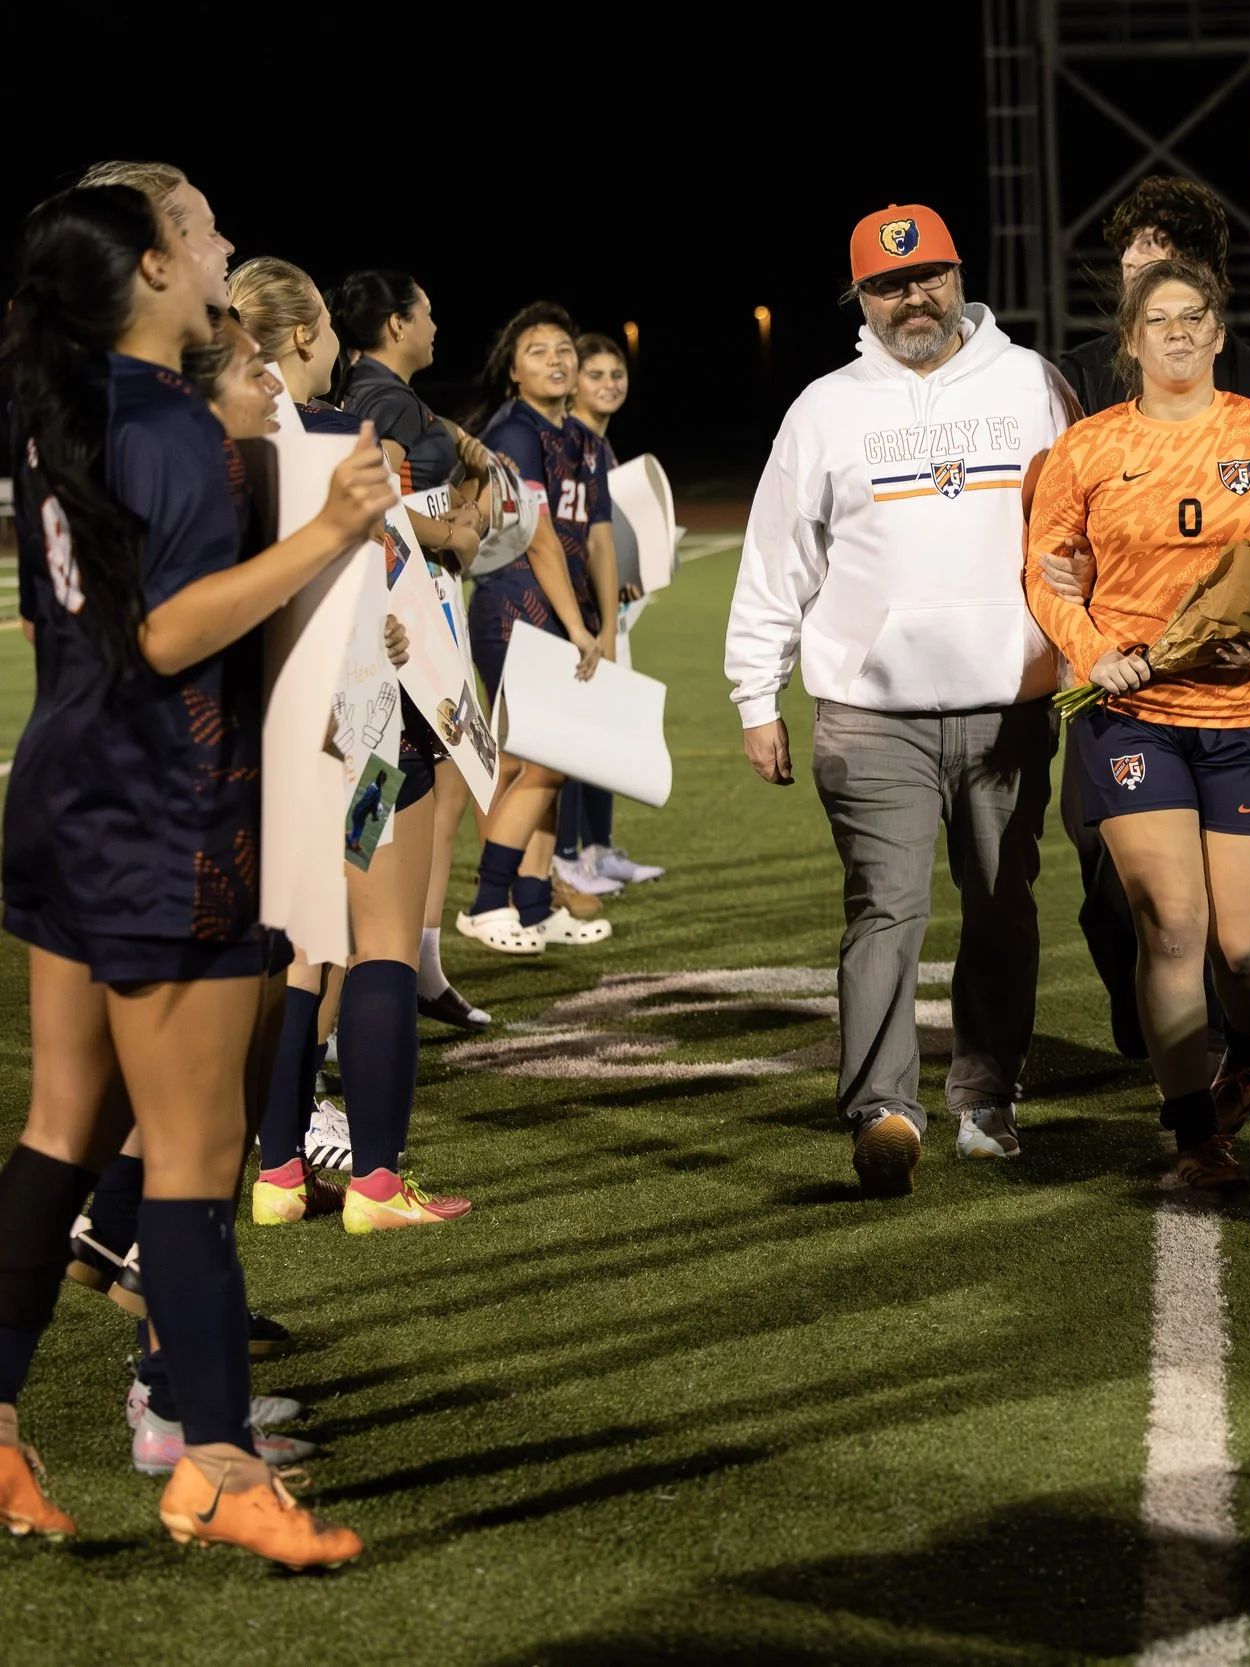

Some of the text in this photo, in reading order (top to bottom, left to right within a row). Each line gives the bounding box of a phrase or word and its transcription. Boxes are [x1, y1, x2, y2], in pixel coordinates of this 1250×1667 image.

[864, 415, 1021, 465] GRIZZLY FC
[557, 477, 590, 523] 21
[1179, 498, 1202, 538] 0
